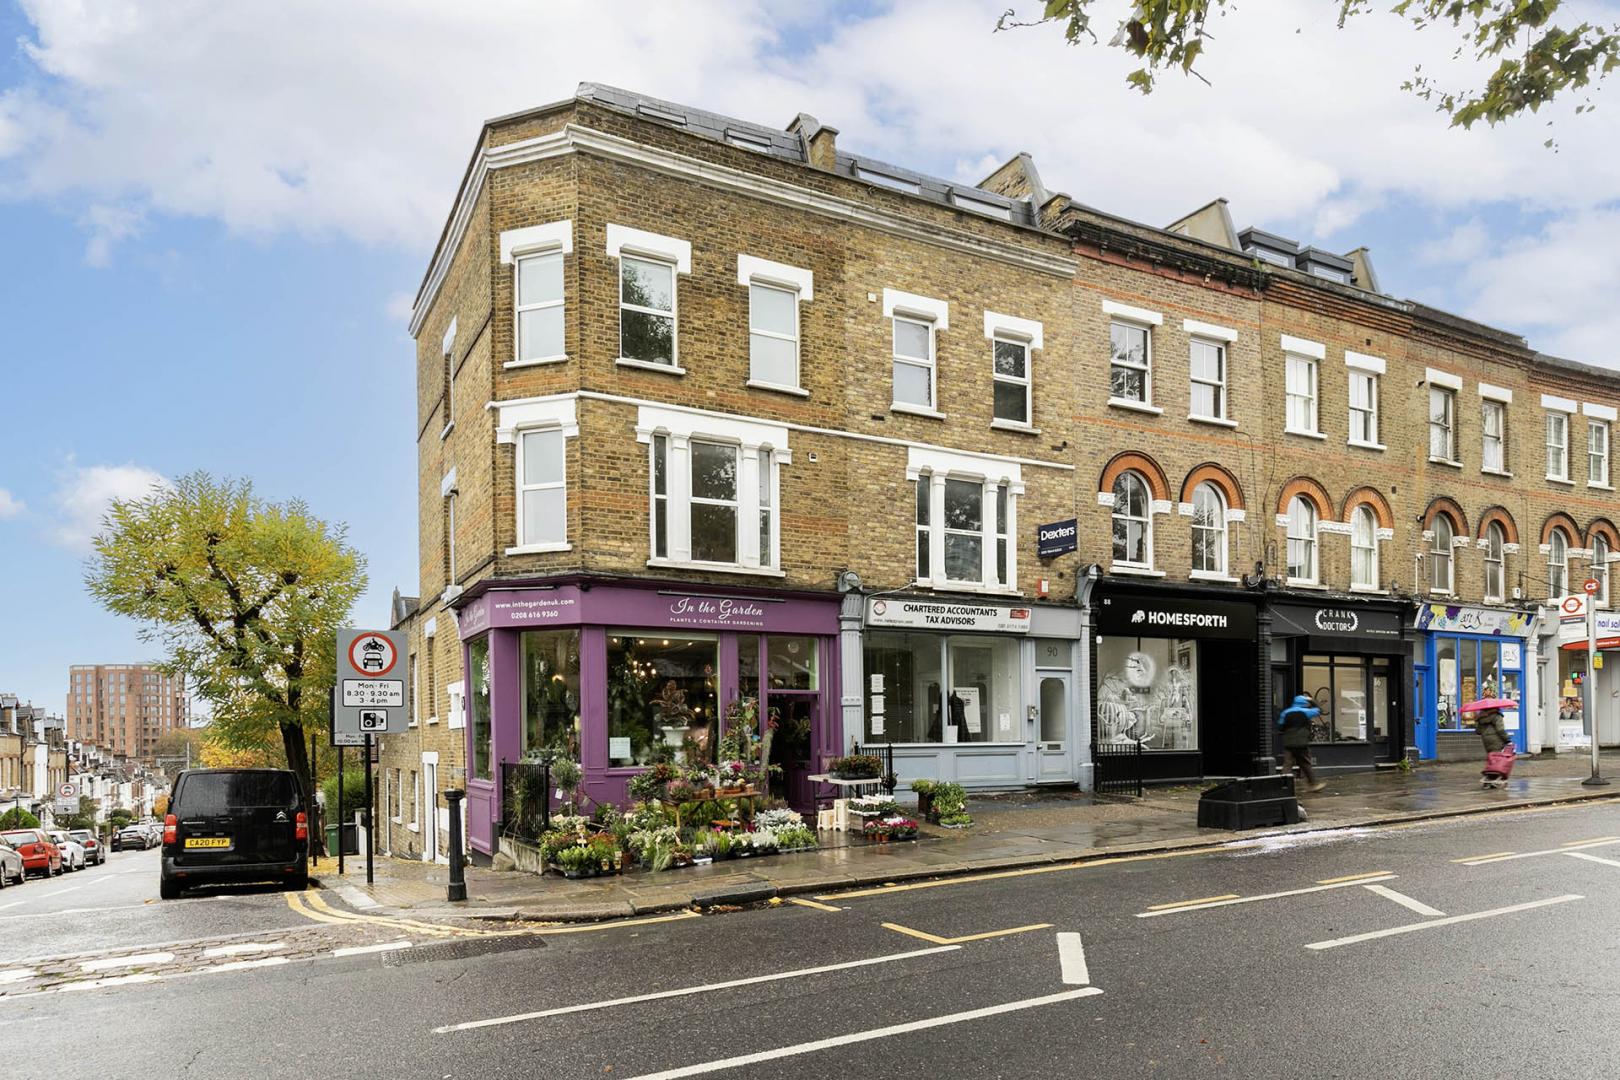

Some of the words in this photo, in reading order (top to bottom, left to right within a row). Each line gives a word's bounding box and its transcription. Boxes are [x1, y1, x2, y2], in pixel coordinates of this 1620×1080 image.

[1041, 527, 1075, 540] Dexters
[495, 599, 574, 609] www.inthegardenuk.com
[670, 598, 694, 614] In
[698, 602, 716, 613] the
[718, 600, 763, 620] Garden
[904, 604, 946, 614] CHARTERED
[947, 606, 997, 616] ACCOUNTANTS
[1323, 609, 1351, 619] CRANK
[926, 615, 941, 624] TAX
[941, 616, 975, 626] ADVISORS
[1148, 611, 1227, 627] HOMESFORTH
[1598, 618, 1610, 628] nail
[1323, 622, 1351, 632] DOCTORS
[1047, 646, 1058, 657] 90
